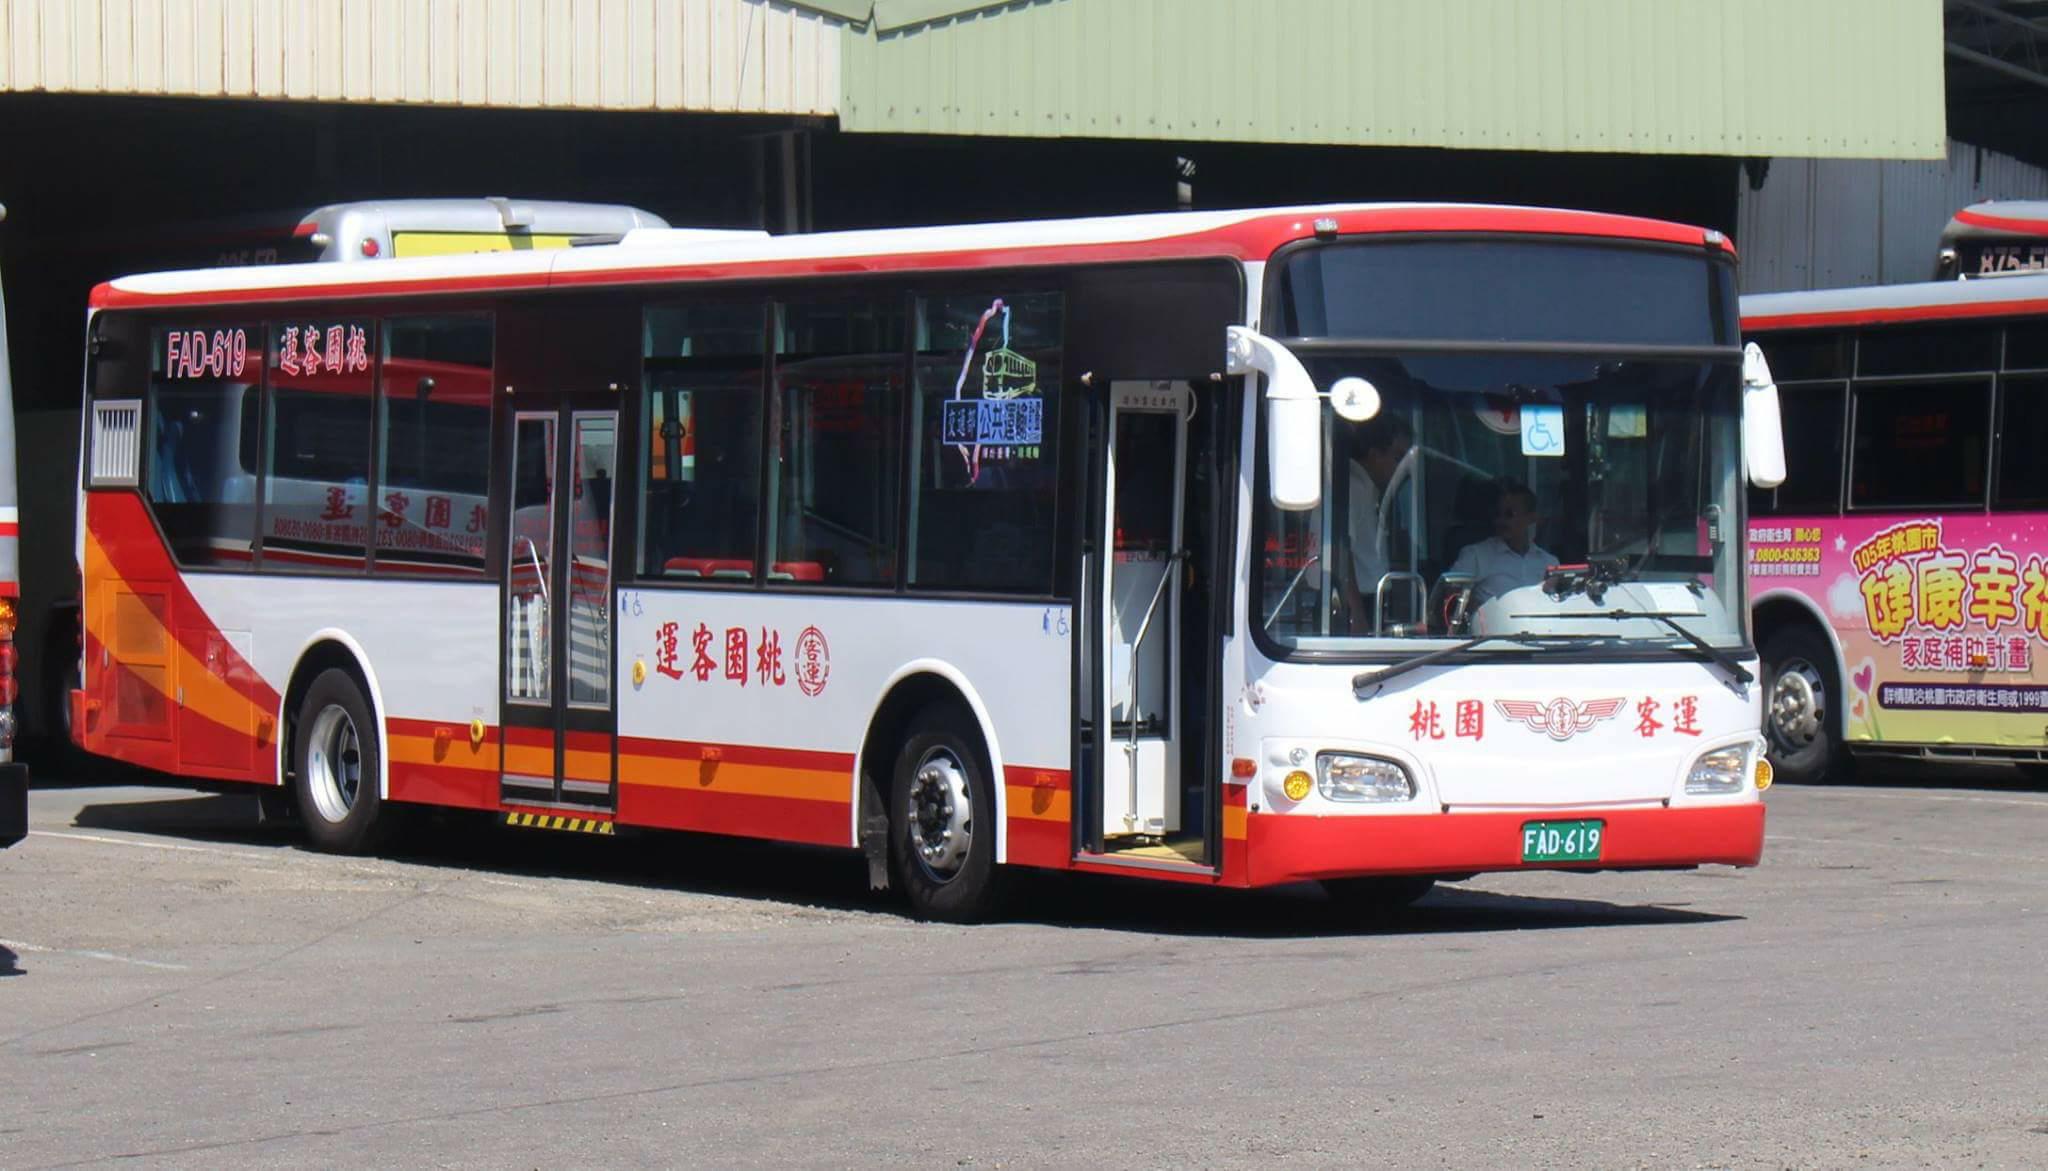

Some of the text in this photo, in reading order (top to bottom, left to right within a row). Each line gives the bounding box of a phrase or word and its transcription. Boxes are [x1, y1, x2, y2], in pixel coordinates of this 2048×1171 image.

[167, 328, 247, 379] FAD-619
[1854, 526, 1938, 572] 105年桃園市
[1902, 637, 2029, 669] 家庭補助計畫
[1409, 695, 1704, 742] 桃園 客運
